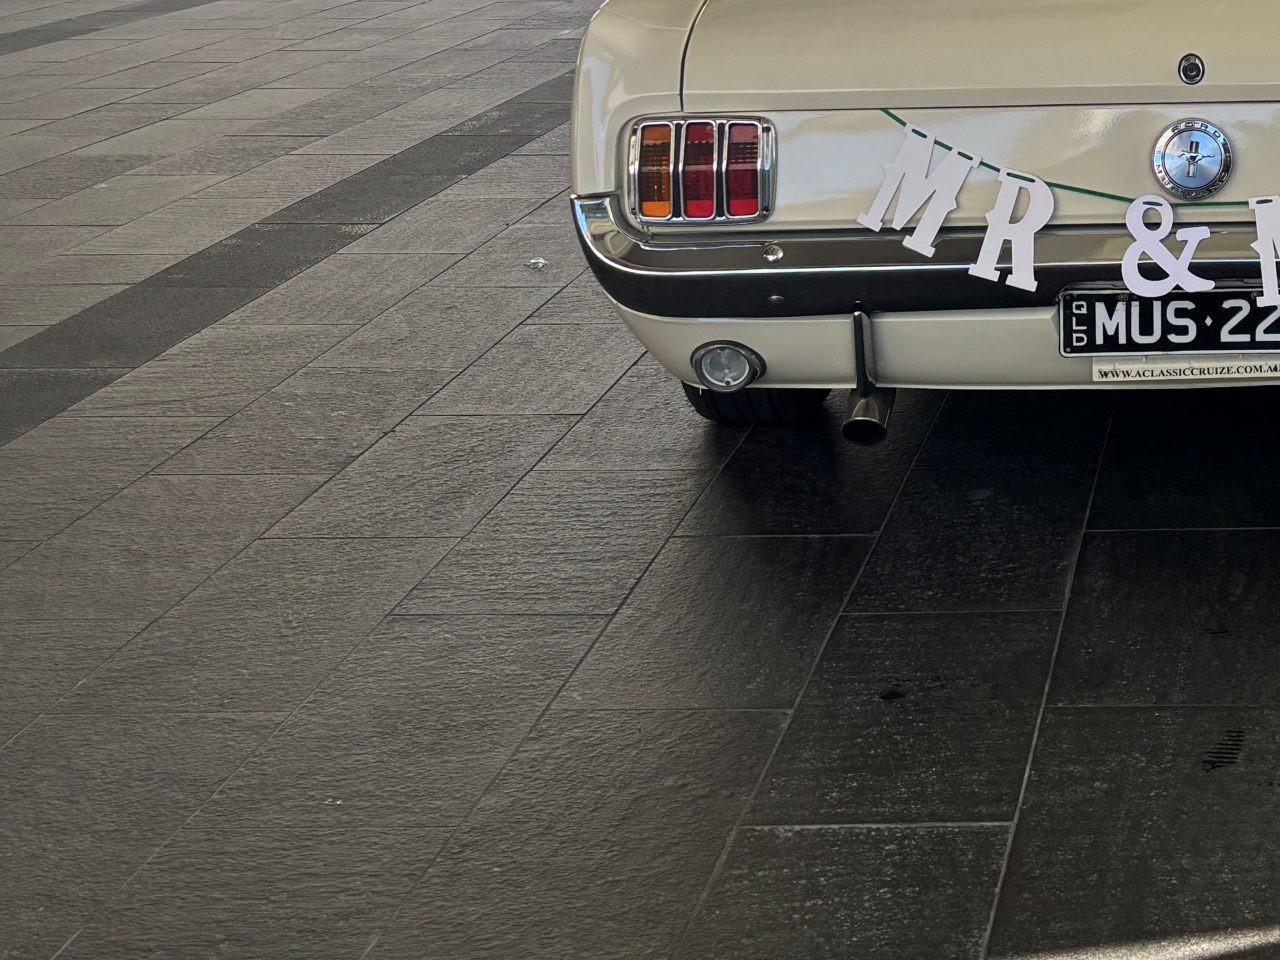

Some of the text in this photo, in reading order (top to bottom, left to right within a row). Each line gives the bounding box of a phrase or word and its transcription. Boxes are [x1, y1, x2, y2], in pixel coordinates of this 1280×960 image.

[856, 122, 1055, 293] MR
[1121, 194, 1216, 298] &
[1072, 301, 1088, 347] QLD
